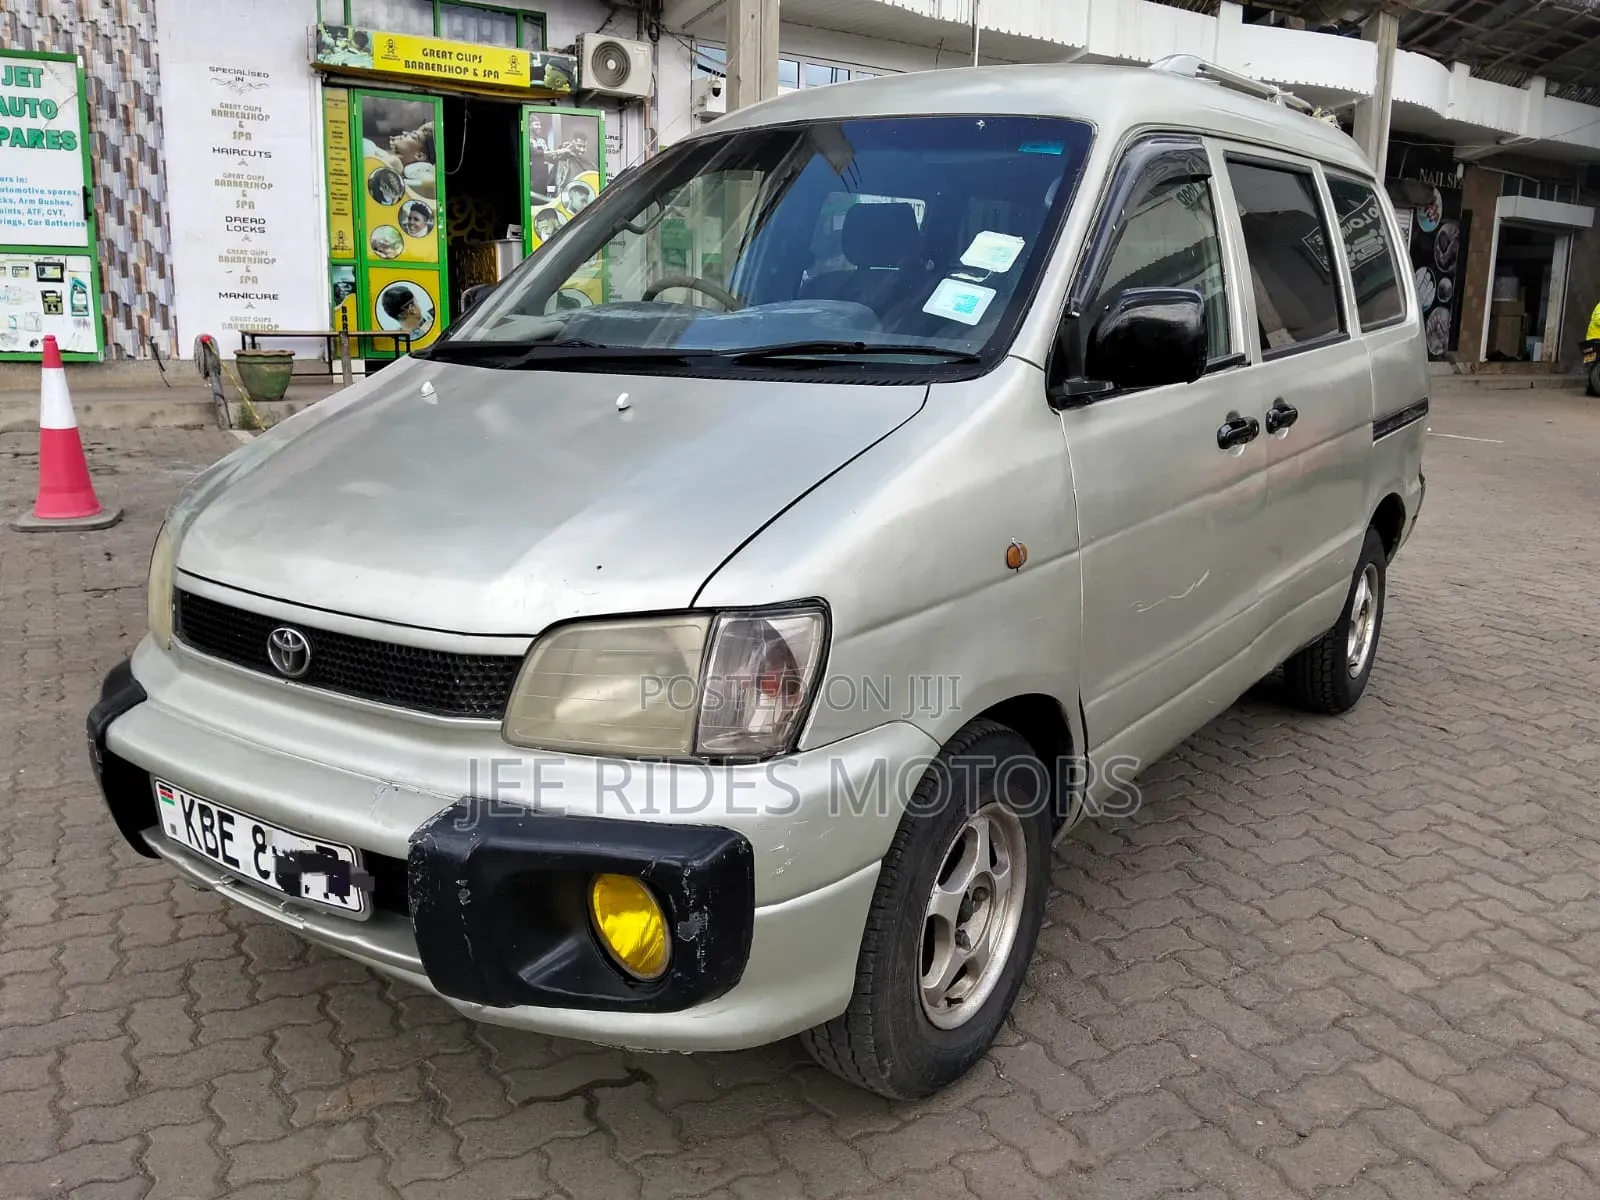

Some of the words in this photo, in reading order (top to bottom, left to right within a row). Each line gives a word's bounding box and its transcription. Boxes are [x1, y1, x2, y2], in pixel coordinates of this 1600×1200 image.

[421, 47, 453, 60] GREAT
[456, 52, 483, 64] CLIPS
[208, 66, 270, 79] SPECIALISED
[404, 60, 469, 76] BARBERSHOP
[472, 68, 479, 77] &
[482, 69, 500, 79] SPA
[1, 65, 44, 88] JET
[211, 109, 270, 122] BARBERSHOP
[232, 130, 252, 141] SPA
[212, 146, 272, 158] HAIRCUTS
[214, 178, 273, 190] BARBERSHOP
[235, 199, 255, 210] SPA
[45, 219, 86, 228] Batteries
[225, 215, 266, 225] DREAD
[226, 224, 266, 234] LOCKS
[218, 255, 277, 265] BARBERSHOP
[239, 275, 258, 285] SPA
[218, 292, 280, 301] MANICURE
[180, 794, 240, 869] KBE
